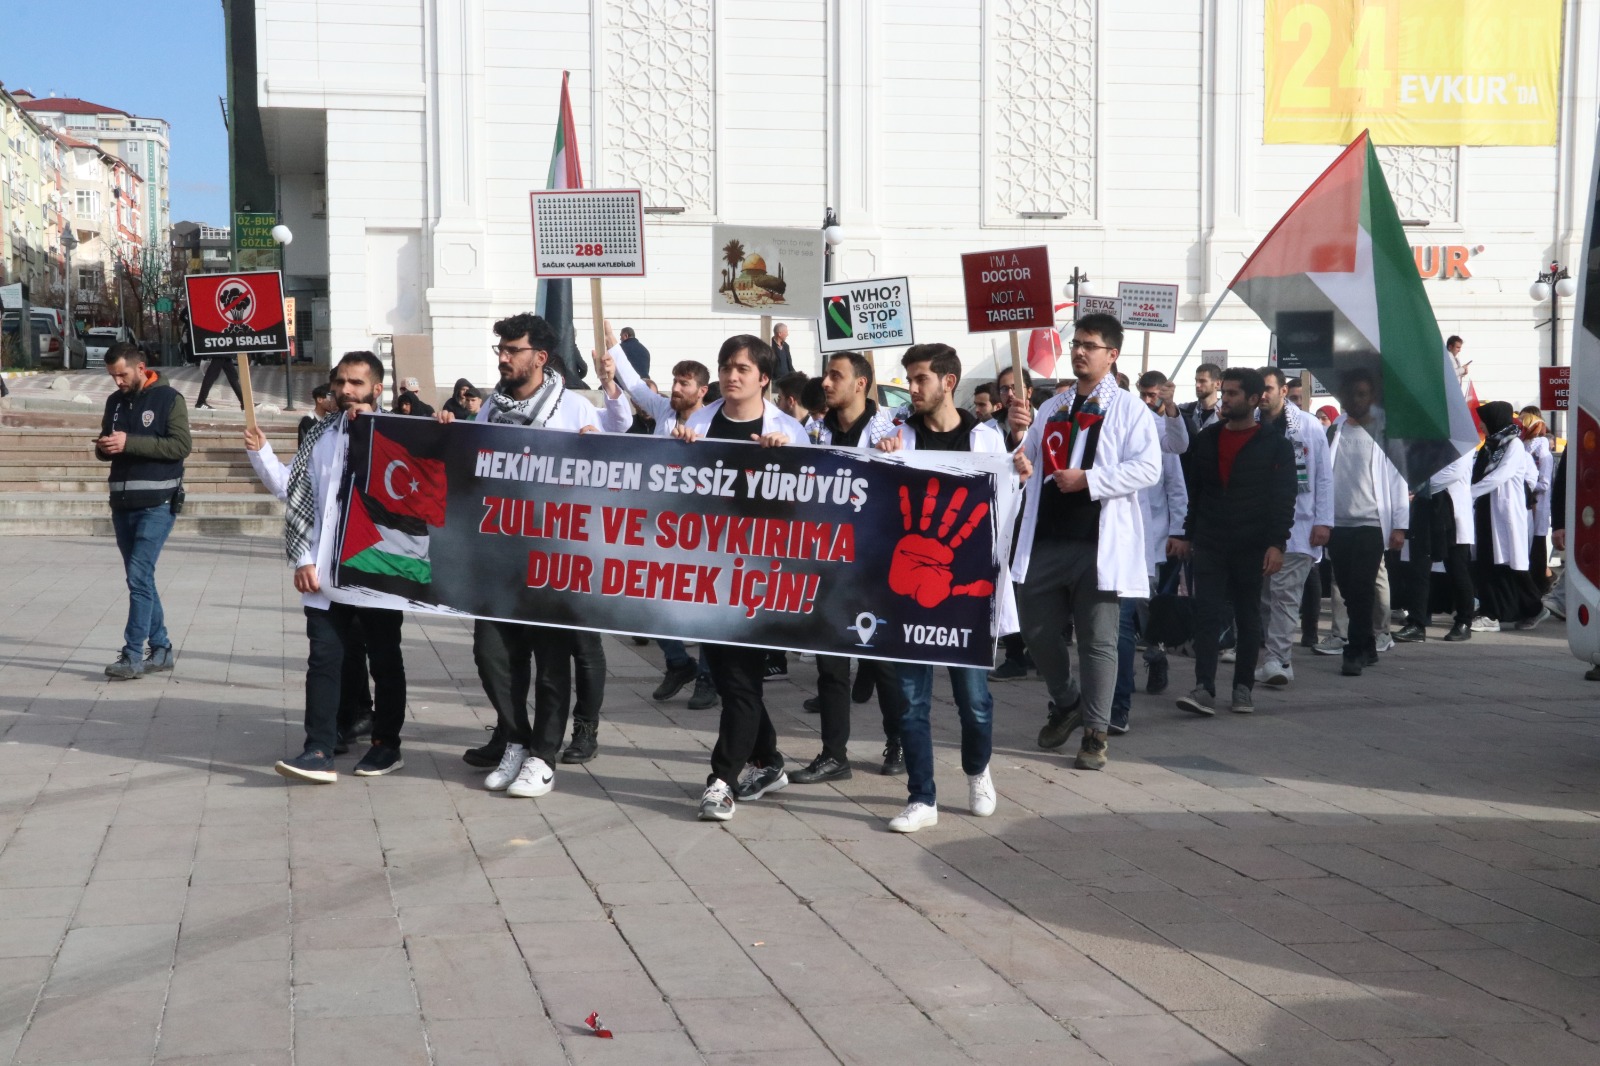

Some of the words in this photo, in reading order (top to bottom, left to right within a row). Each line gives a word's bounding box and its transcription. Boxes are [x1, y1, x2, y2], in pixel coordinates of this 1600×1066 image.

[1278, 3, 1393, 110] 24
[237, 214, 276, 226] ÖZ-BUR
[772, 237, 788, 246] from
[789, 239, 798, 247] to
[799, 239, 815, 248] river
[574, 243, 604, 257] 288
[778, 247, 787, 256] to
[788, 247, 800, 257] the
[800, 249, 814, 257] sea
[541, 261, 566, 269] SAĞLIK
[566, 261, 597, 270] ÇALIŞANI
[989, 255, 1007, 268] I'M
[1011, 254, 1020, 266] A
[1414, 245, 1472, 278] UR
[981, 267, 1031, 284] DOCTOR
[850, 285, 902, 303] WHO?
[991, 291, 1014, 305] NOT
[1015, 290, 1025, 303] A
[862, 302, 889, 311] GOING
[890, 300, 902, 308] TO
[1085, 298, 1115, 310] BEYAZ
[858, 309, 898, 324] STOP
[985, 307, 1035, 323] TARGET!
[871, 322, 888, 330] THE
[204, 336, 233, 348] STOP
[235, 334, 277, 347] ISRAEL!
[856, 330, 904, 341] GENOCIDE
[1559, 368, 1570, 377] BE
[1554, 389, 1570, 397] HED
[1556, 399, 1568, 407] DE
[474, 445, 643, 491] HEKİMLERDEN
[647, 459, 739, 498] SESSİZ
[744, 462, 869, 513] YÜRÜYÜŞ
[478, 495, 592, 542] ZULME
[600, 506, 648, 546] VE
[654, 510, 856, 563] SOYKIRIMA
[526, 549, 594, 595] DUR
[600, 557, 723, 606] DEMEK
[728, 557, 821, 619] İÇİN!
[902, 623, 973, 648] YOZGAT
